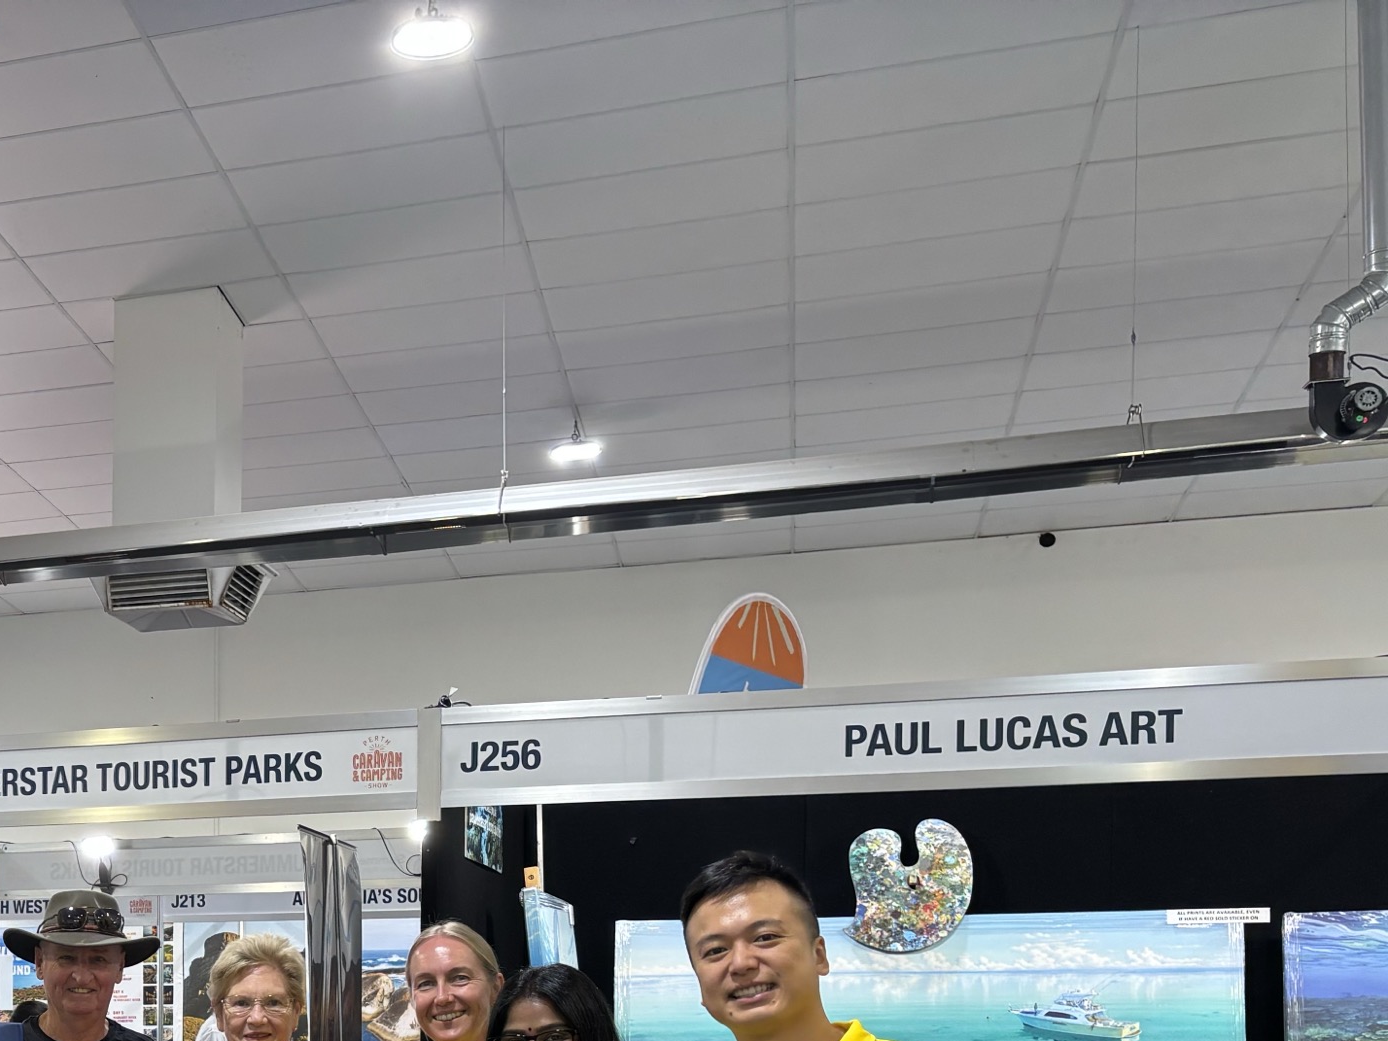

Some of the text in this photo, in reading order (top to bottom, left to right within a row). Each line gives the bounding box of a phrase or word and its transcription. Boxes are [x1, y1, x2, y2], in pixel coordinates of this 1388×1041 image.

[362, 735, 392, 747] PERTH
[844, 709, 1184, 758] PAUL LUCAS ART
[352, 749, 403, 770] CARAVAN
[460, 740, 542, 774] J256
[96, 756, 216, 792] TOURIST
[225, 750, 323, 784] PARKS
[360, 768, 403, 781] CAMPING
[171, 894, 206, 908] J213
